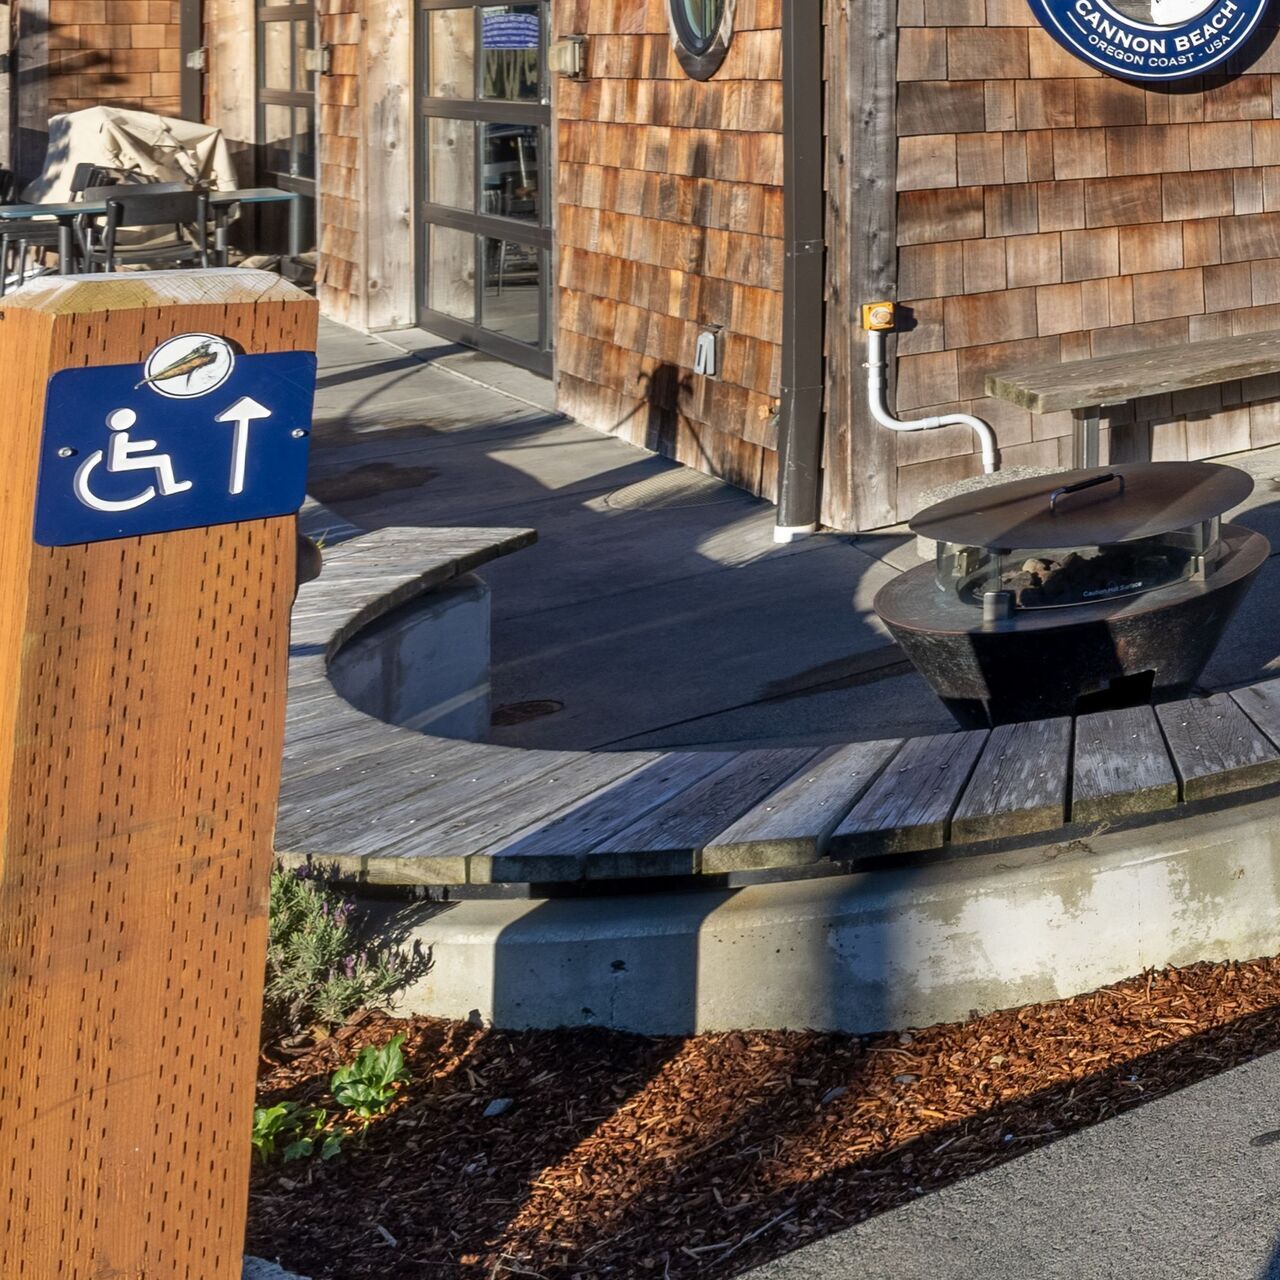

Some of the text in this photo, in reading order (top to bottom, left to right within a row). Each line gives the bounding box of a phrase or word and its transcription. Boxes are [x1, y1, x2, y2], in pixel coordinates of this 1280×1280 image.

[1173, 0, 1238, 52] BEACH
[1088, 34, 1144, 65] OREGON
[1148, 53, 1195, 67] COAST
[1204, 35, 1231, 55] USA
